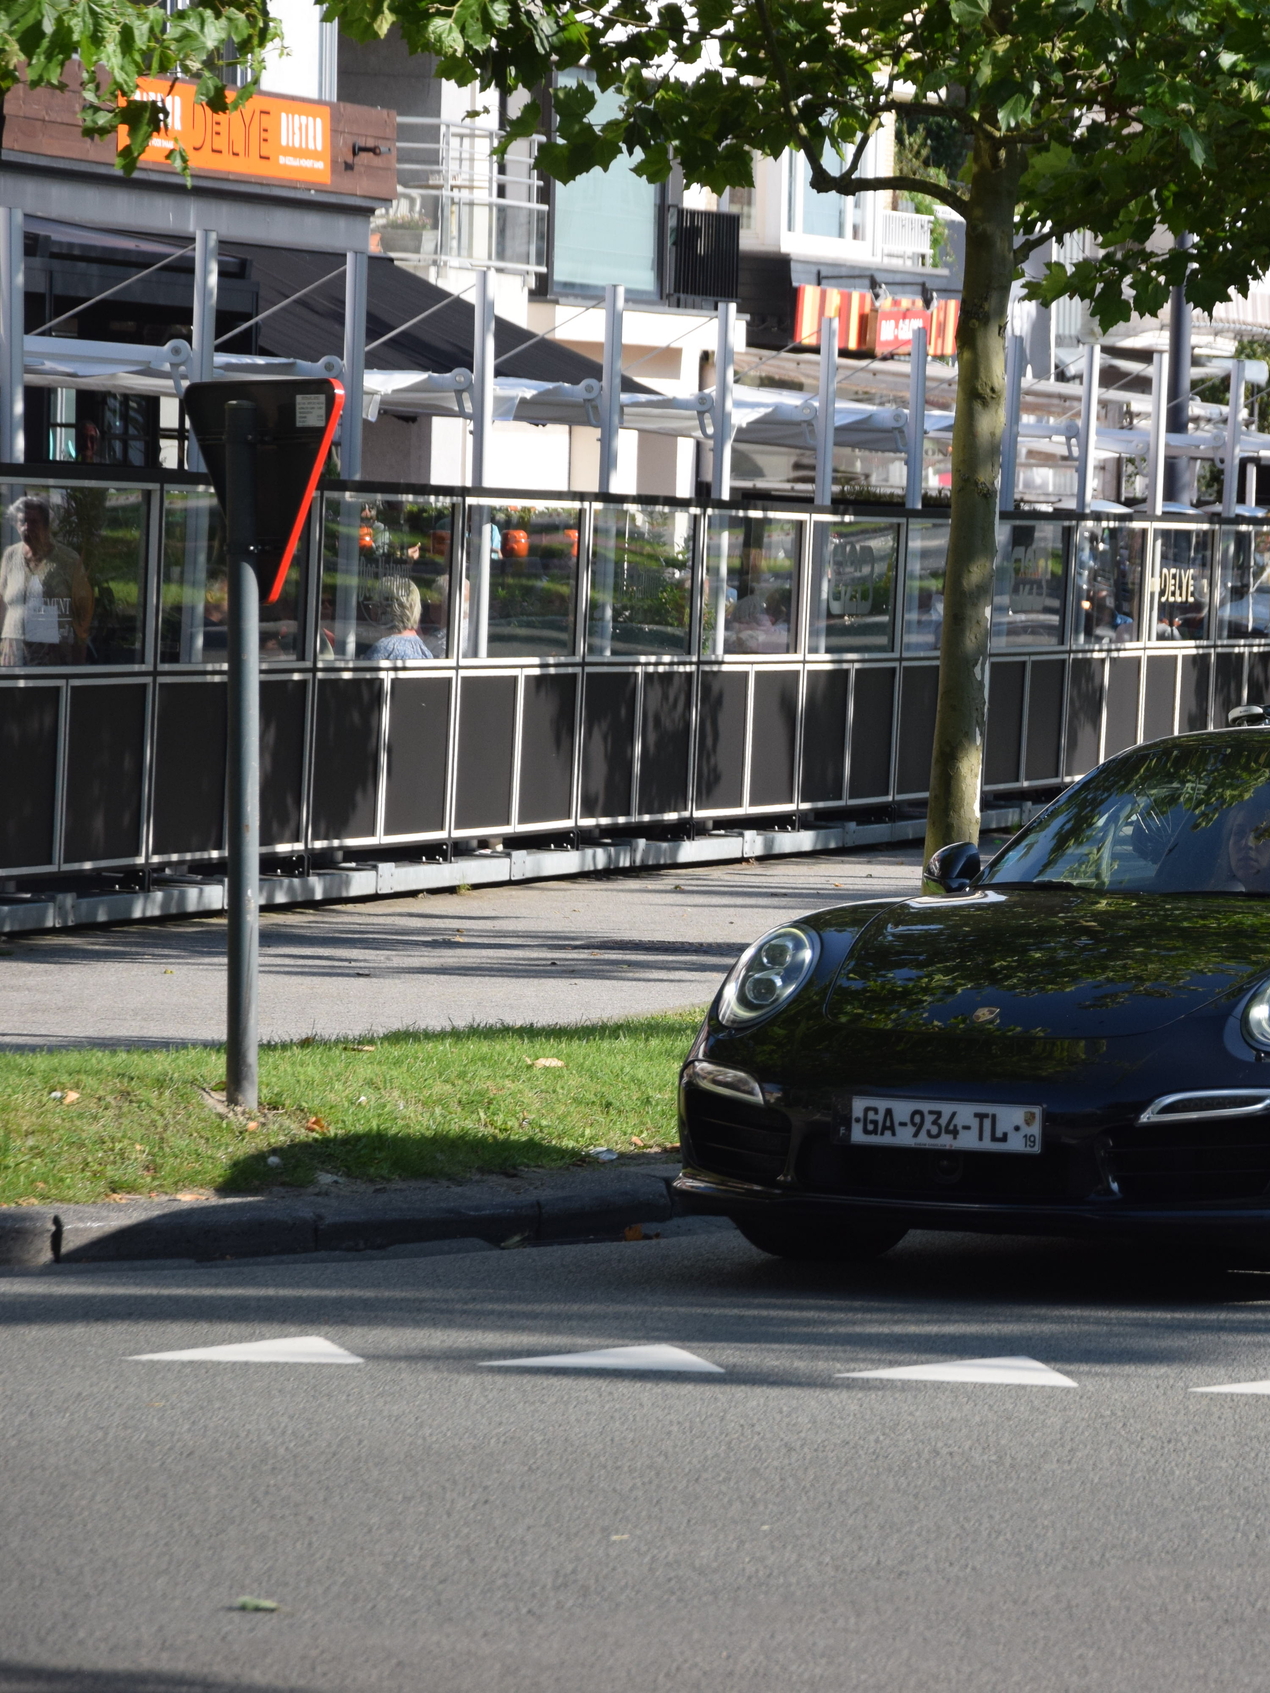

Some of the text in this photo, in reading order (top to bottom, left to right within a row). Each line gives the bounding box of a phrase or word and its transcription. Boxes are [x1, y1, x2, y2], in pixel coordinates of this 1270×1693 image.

[192, 101, 271, 160] DELYE
[1161, 568, 1195, 603] DELYE
[862, 1105, 1008, 1143] GA-934-TL
[1022, 1133, 1036, 1149] 19
